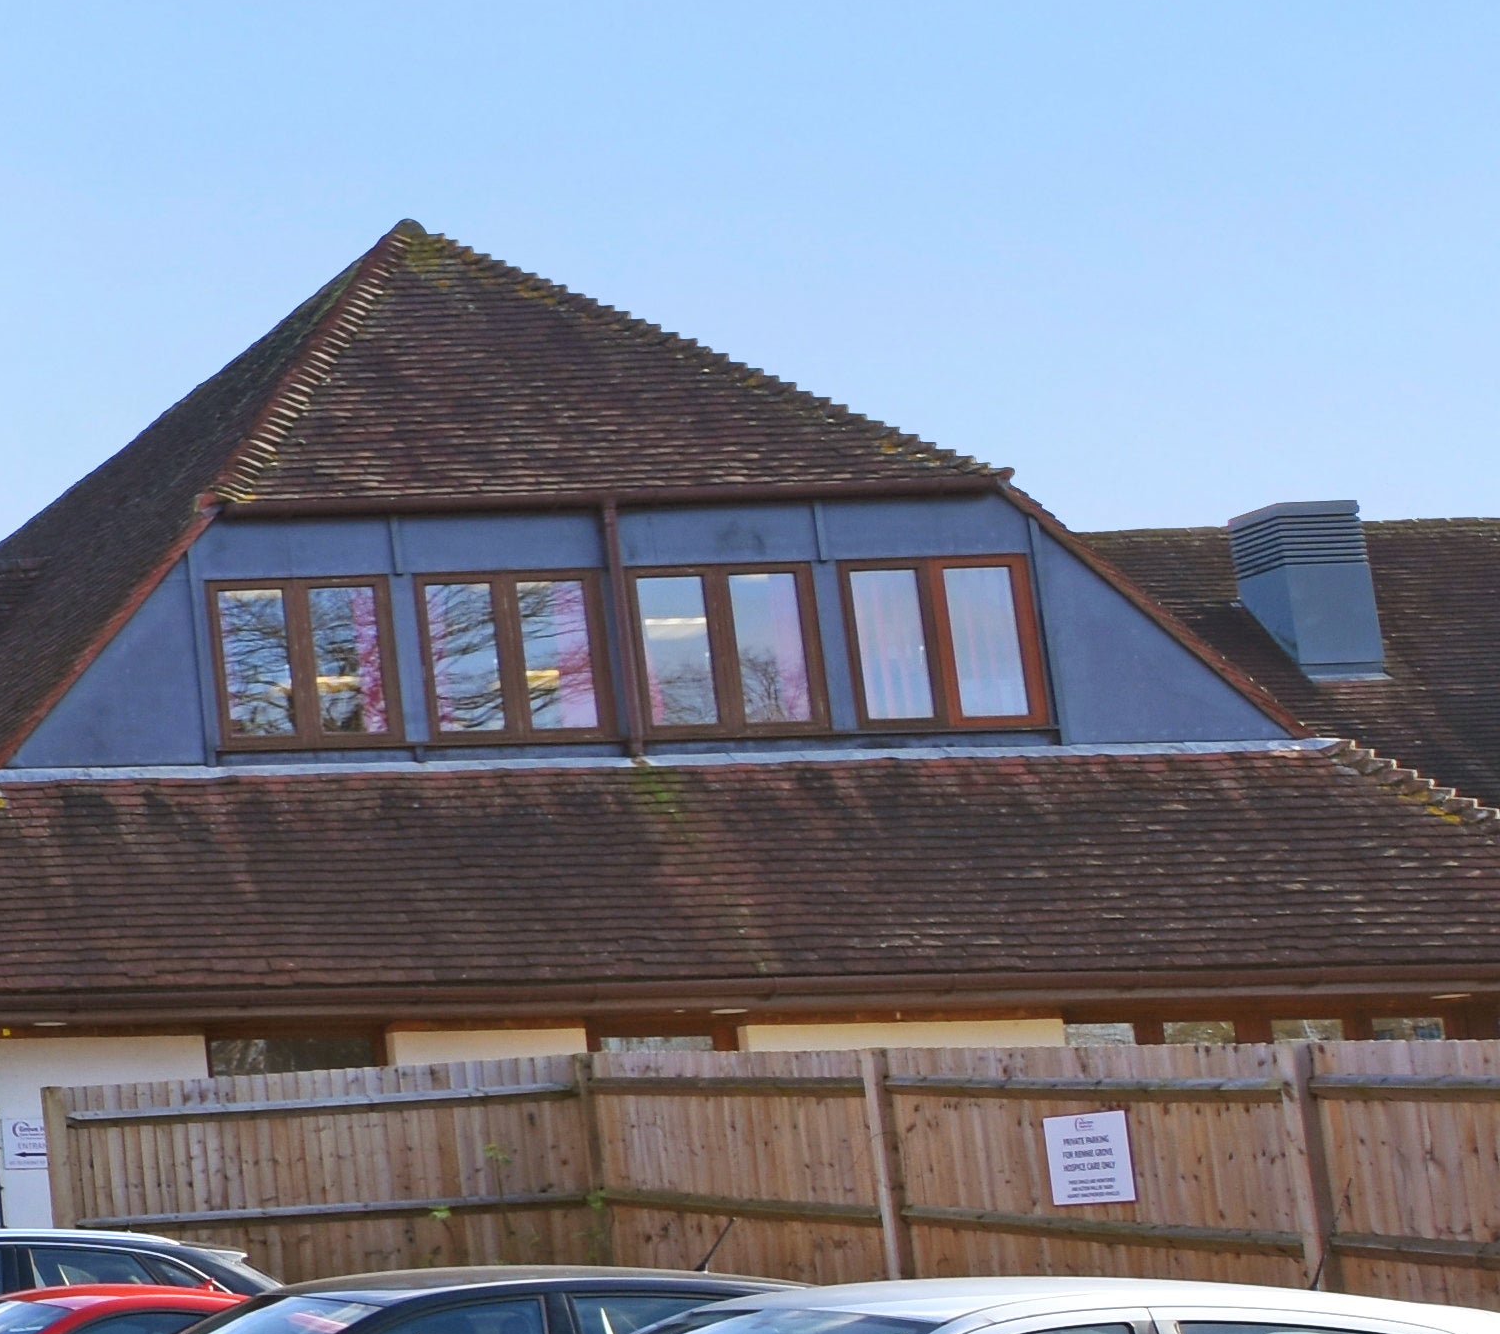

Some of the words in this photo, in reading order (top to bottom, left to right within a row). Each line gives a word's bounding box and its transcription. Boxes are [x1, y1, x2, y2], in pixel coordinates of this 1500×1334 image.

[1063, 1137, 1084, 1146] PRIVATE
[1086, 1135, 1109, 1143] PARKING
[1062, 1151, 1073, 1159] FOR
[1095, 1148, 1114, 1157] GROVE
[1063, 1163, 1086, 1172] HOSPICE
[1087, 1162, 1100, 1170] CARE
[1101, 1161, 1115, 1170] ONLY
